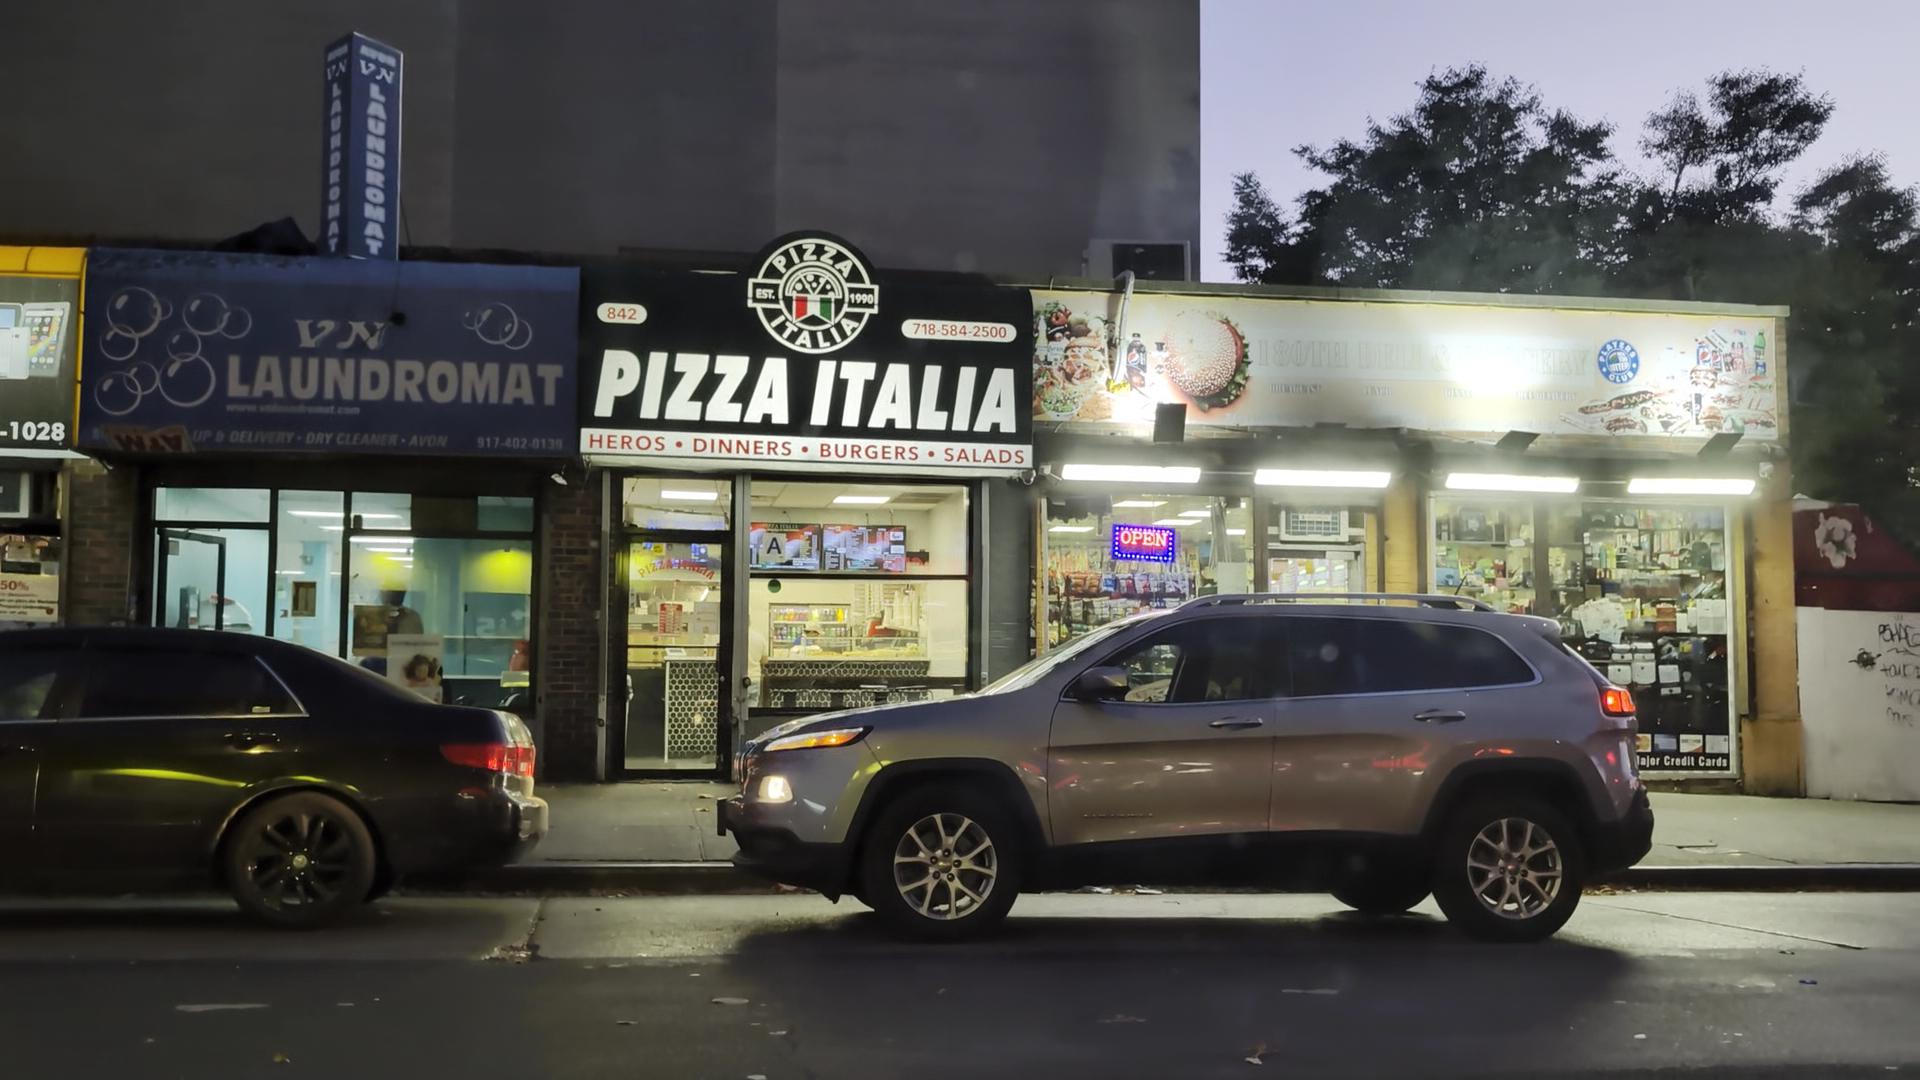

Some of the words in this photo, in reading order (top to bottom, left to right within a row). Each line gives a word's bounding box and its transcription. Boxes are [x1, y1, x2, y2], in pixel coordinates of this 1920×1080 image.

[363, 82, 387, 255] LAUNDROMAT
[771, 243, 853, 278] PIZZA
[755, 288, 776, 300] EST.
[850, 293, 874, 304] 1990
[606, 307, 637, 321] 842
[770, 314, 860, 348] ITALIA
[912, 322, 1007, 338] 718-584-2500
[226, 355, 564, 406] LAUNDROMAT
[593, 349, 789, 424] PIZZA
[810, 359, 1017, 433] ITALIA
[192, 430, 212, 442] UP
[229, 430, 294, 444] DELIVERY
[305, 431, 331, 445] DRY
[336, 432, 398, 446] CLEANER
[409, 434, 448, 447] AVON
[589, 433, 666, 452] HEROS
[693, 437, 792, 456] DINNERS
[820, 443, 919, 461] BURGERS
[944, 447, 1025, 464] SALADS
[767, 536, 782, 555] A
[1120, 530, 1168, 546] OPEN
[1664, 755, 1695, 766] Credit
[1699, 756, 1728, 767] Cards
